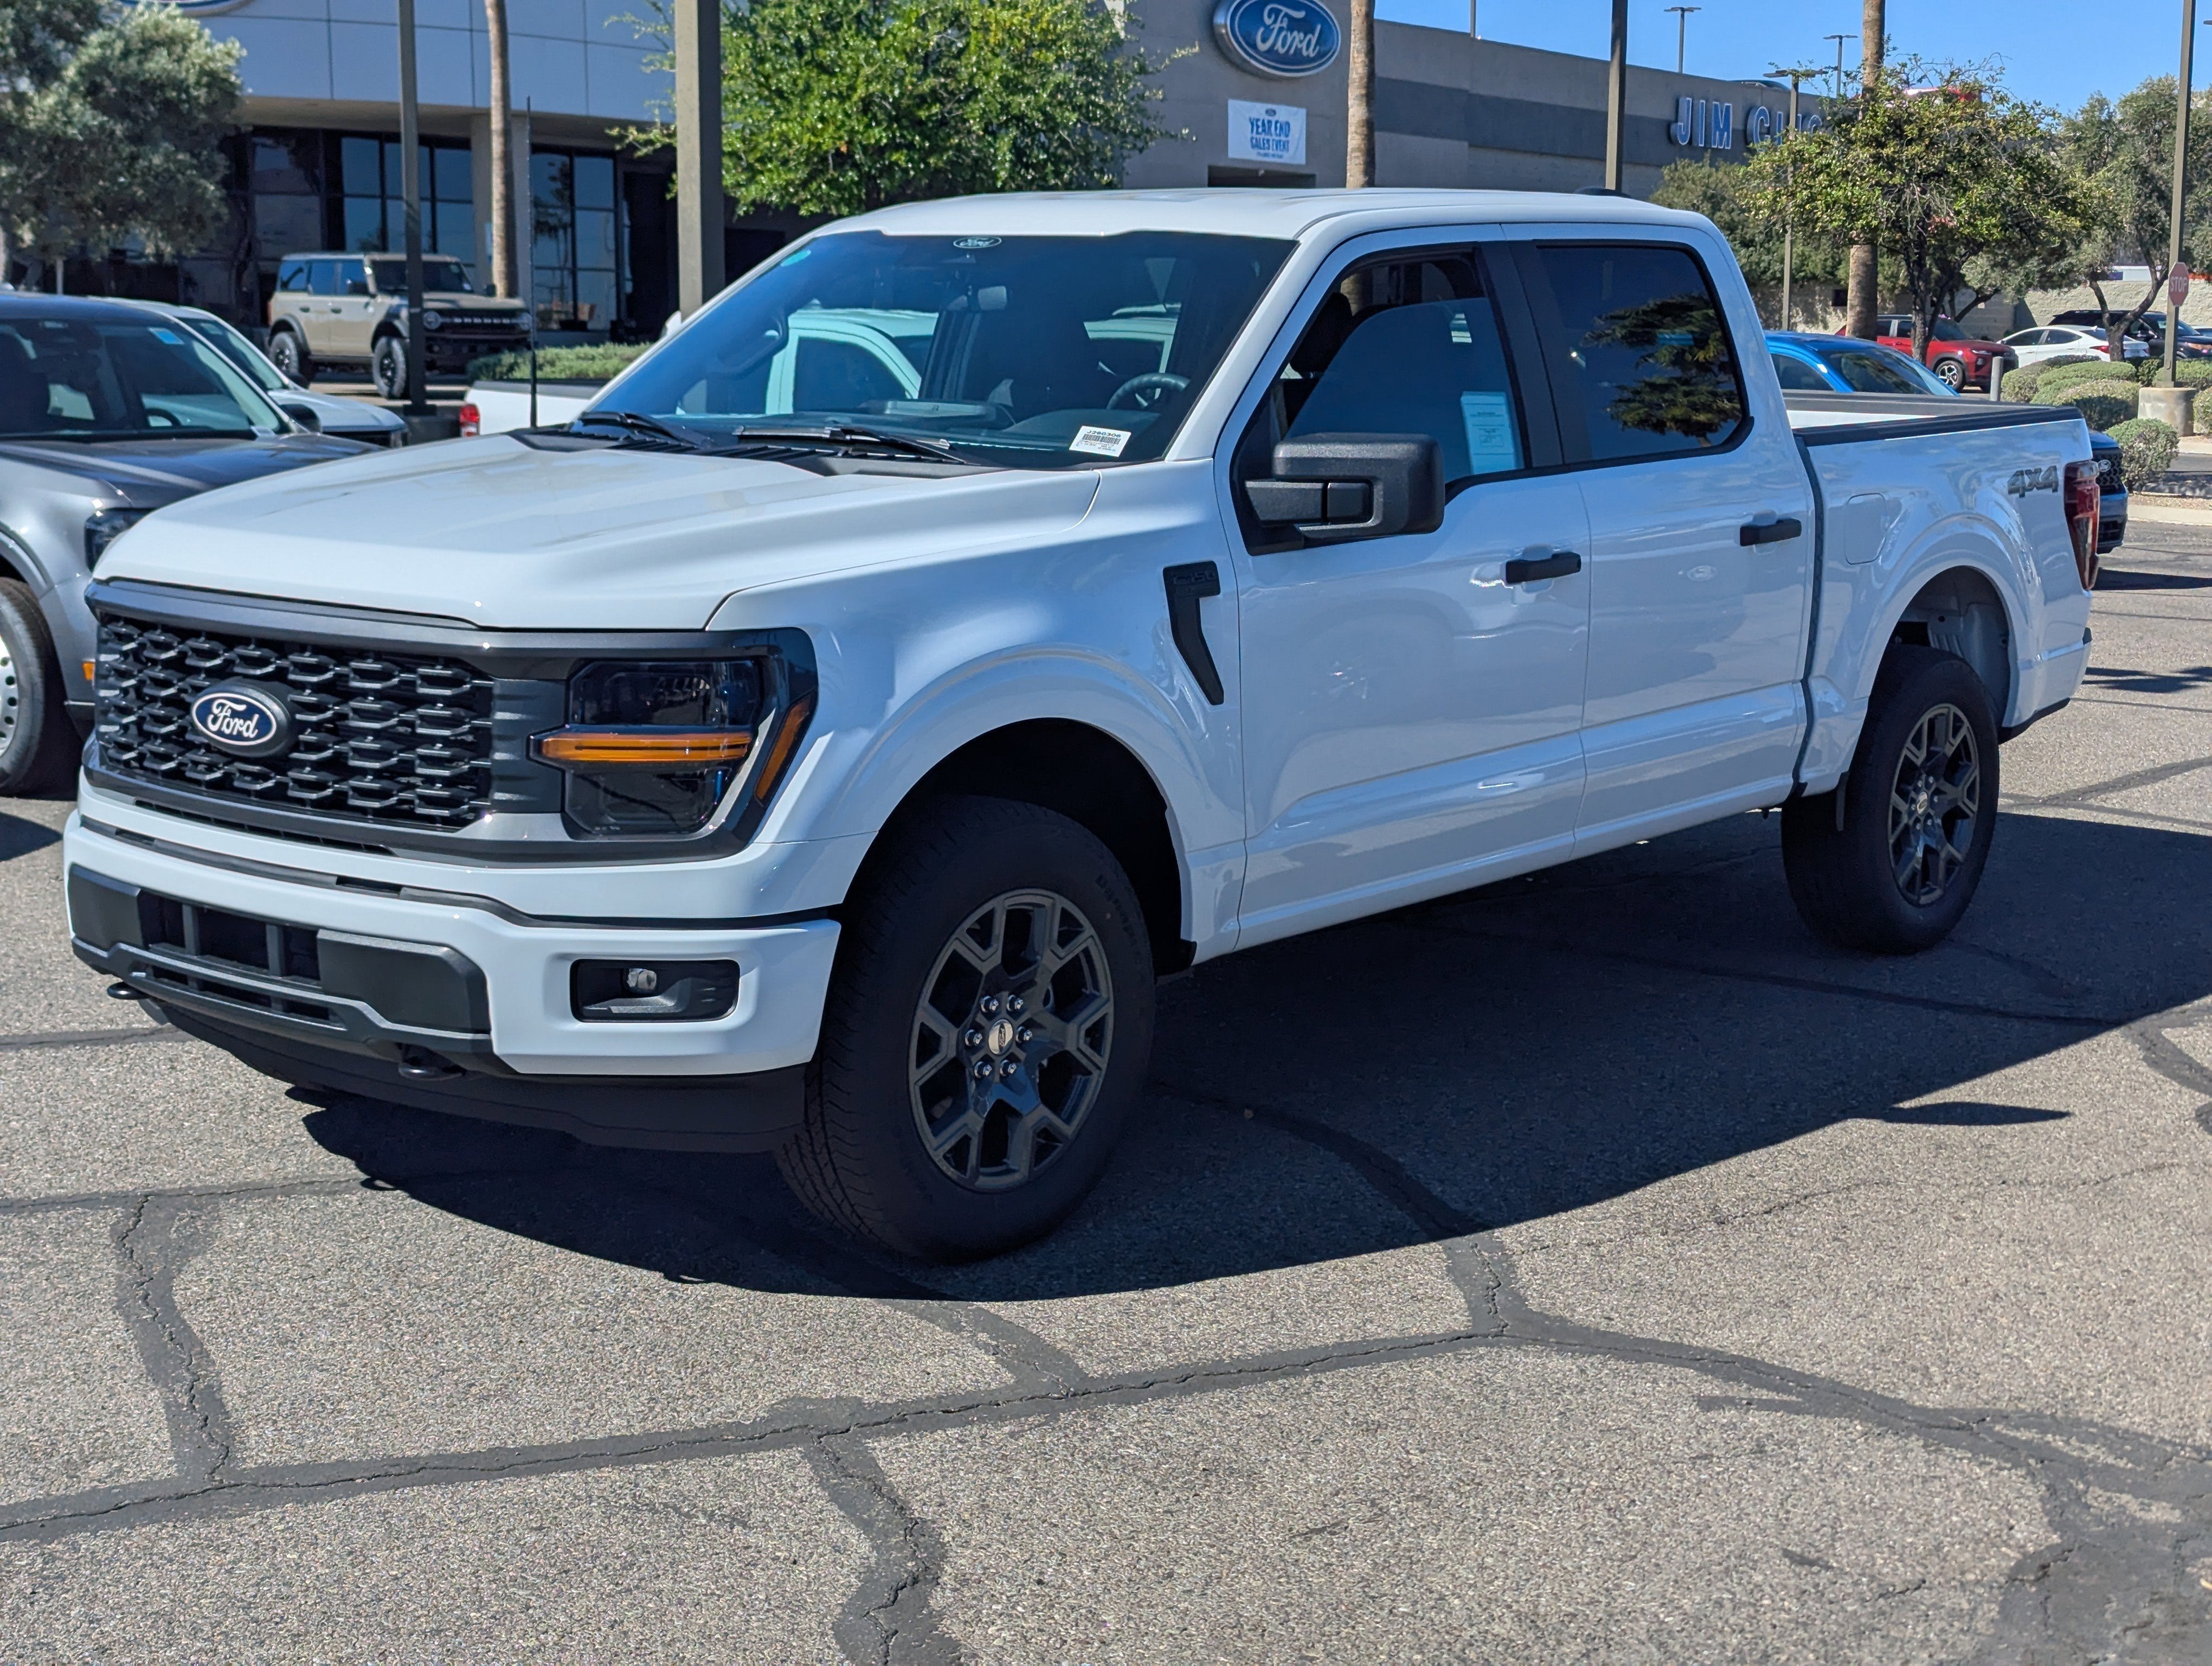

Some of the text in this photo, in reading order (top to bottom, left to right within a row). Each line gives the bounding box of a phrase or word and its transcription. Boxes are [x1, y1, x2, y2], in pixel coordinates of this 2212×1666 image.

[1256, 3, 1321, 58] Ford
[1249, 117, 1291, 138] YEAR END
[1675, 97, 1733, 150] JIM
[2170, 276, 2188, 292] STOP
[207, 699, 260, 739] Ford
